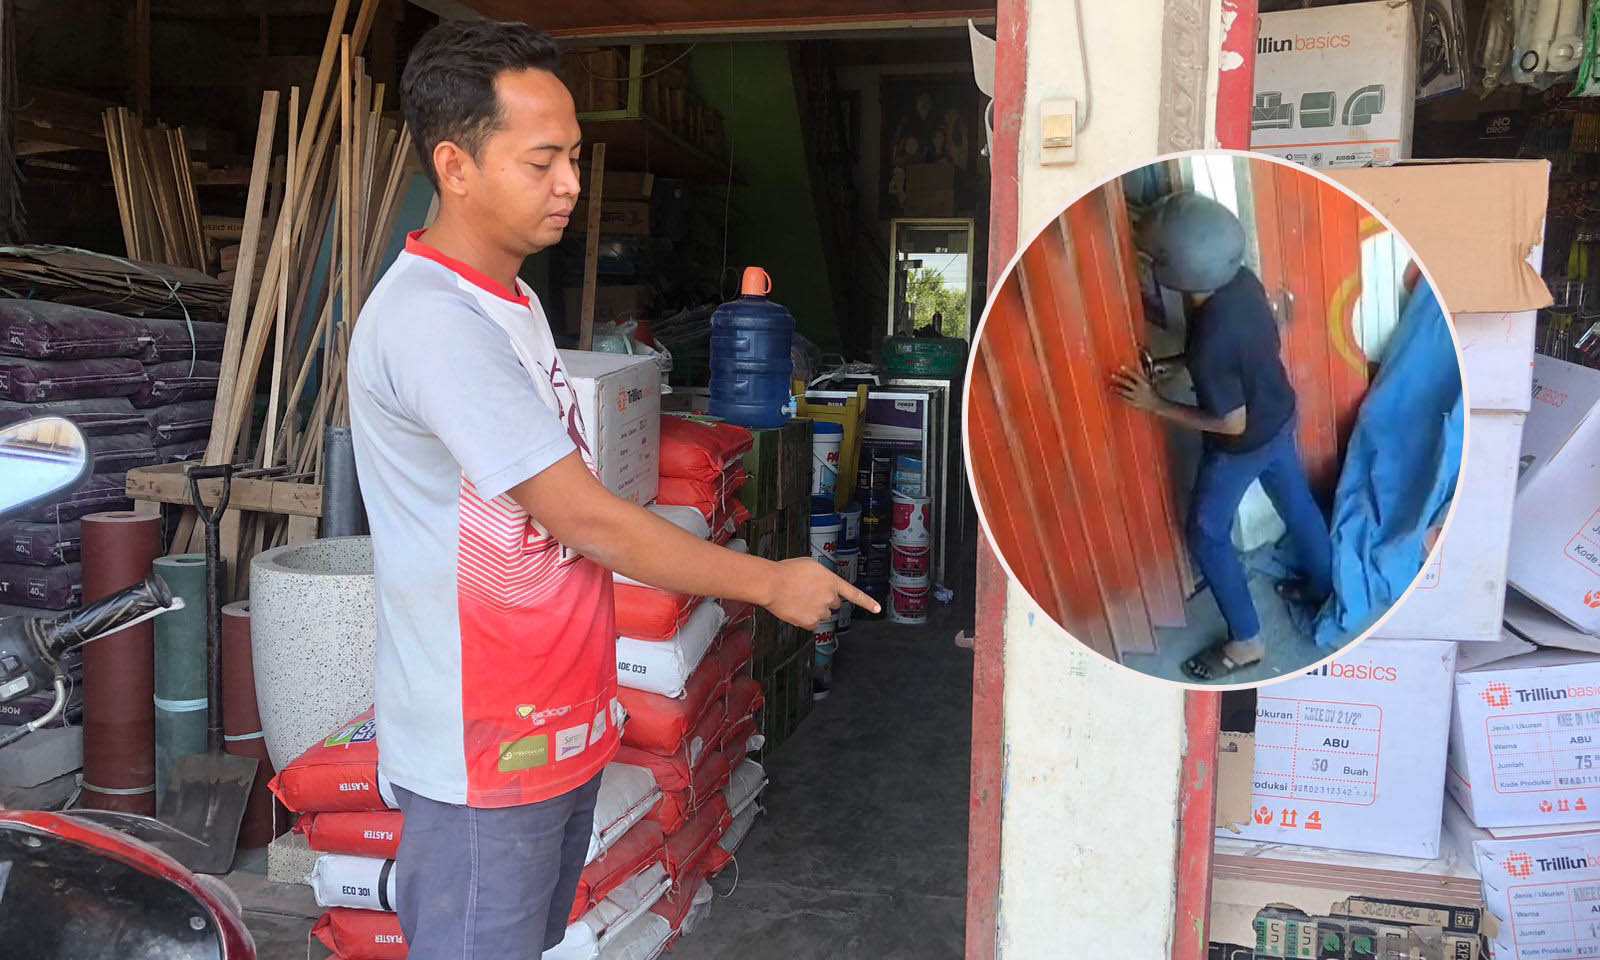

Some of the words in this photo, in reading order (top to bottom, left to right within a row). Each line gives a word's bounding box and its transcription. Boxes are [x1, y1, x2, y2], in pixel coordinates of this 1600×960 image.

[1574, 544, 1598, 564] Kode
[632, 664, 647, 674] ECO
[1323, 738, 1350, 749] ABU
[1570, 735, 1592, 745] ABU
[1575, 754, 1592, 769] 75
[1311, 758, 1328, 773] 50
[1343, 766, 1369, 777] Buah
[339, 782, 369, 791] PLASTER
[364, 830, 393, 841] PLASTER
[342, 885, 356, 896] ECO
[358, 887, 371, 897] 301
[1455, 914, 1473, 926] EXP
[374, 935, 403, 944] PLASTER
